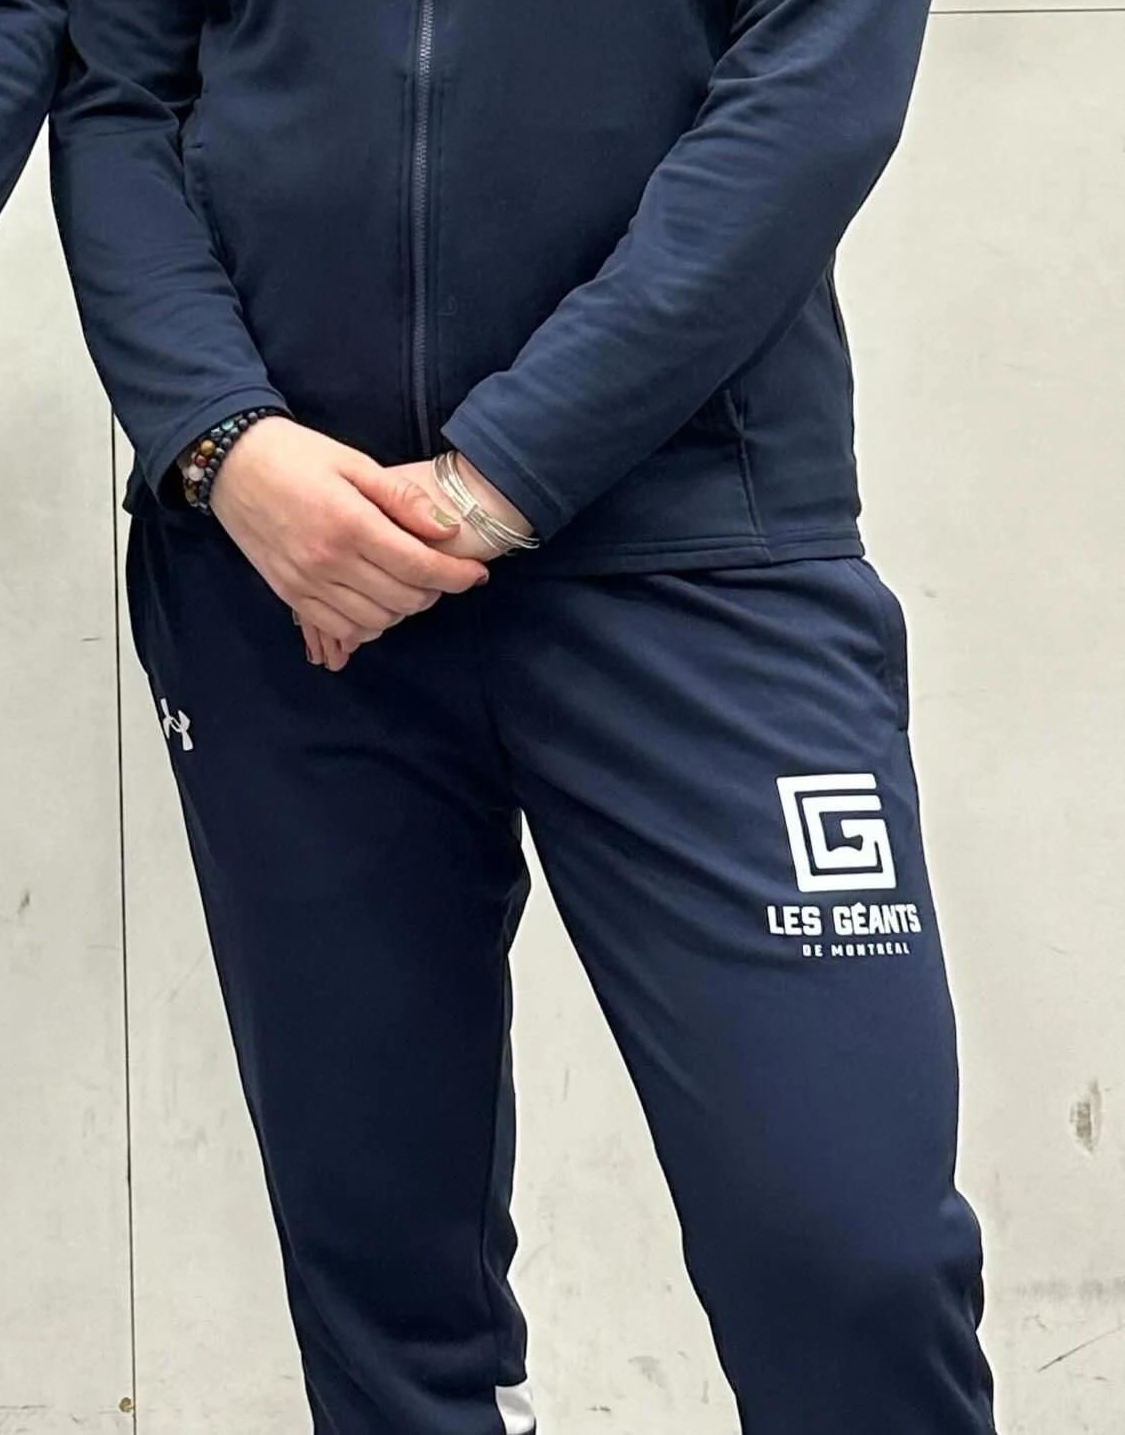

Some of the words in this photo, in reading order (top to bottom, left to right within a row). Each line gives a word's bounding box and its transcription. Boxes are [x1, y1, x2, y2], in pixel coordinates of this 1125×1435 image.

[767, 905, 822, 935] LES
[832, 901, 922, 935] GÉANTS
[802, 944, 823, 957] DE
